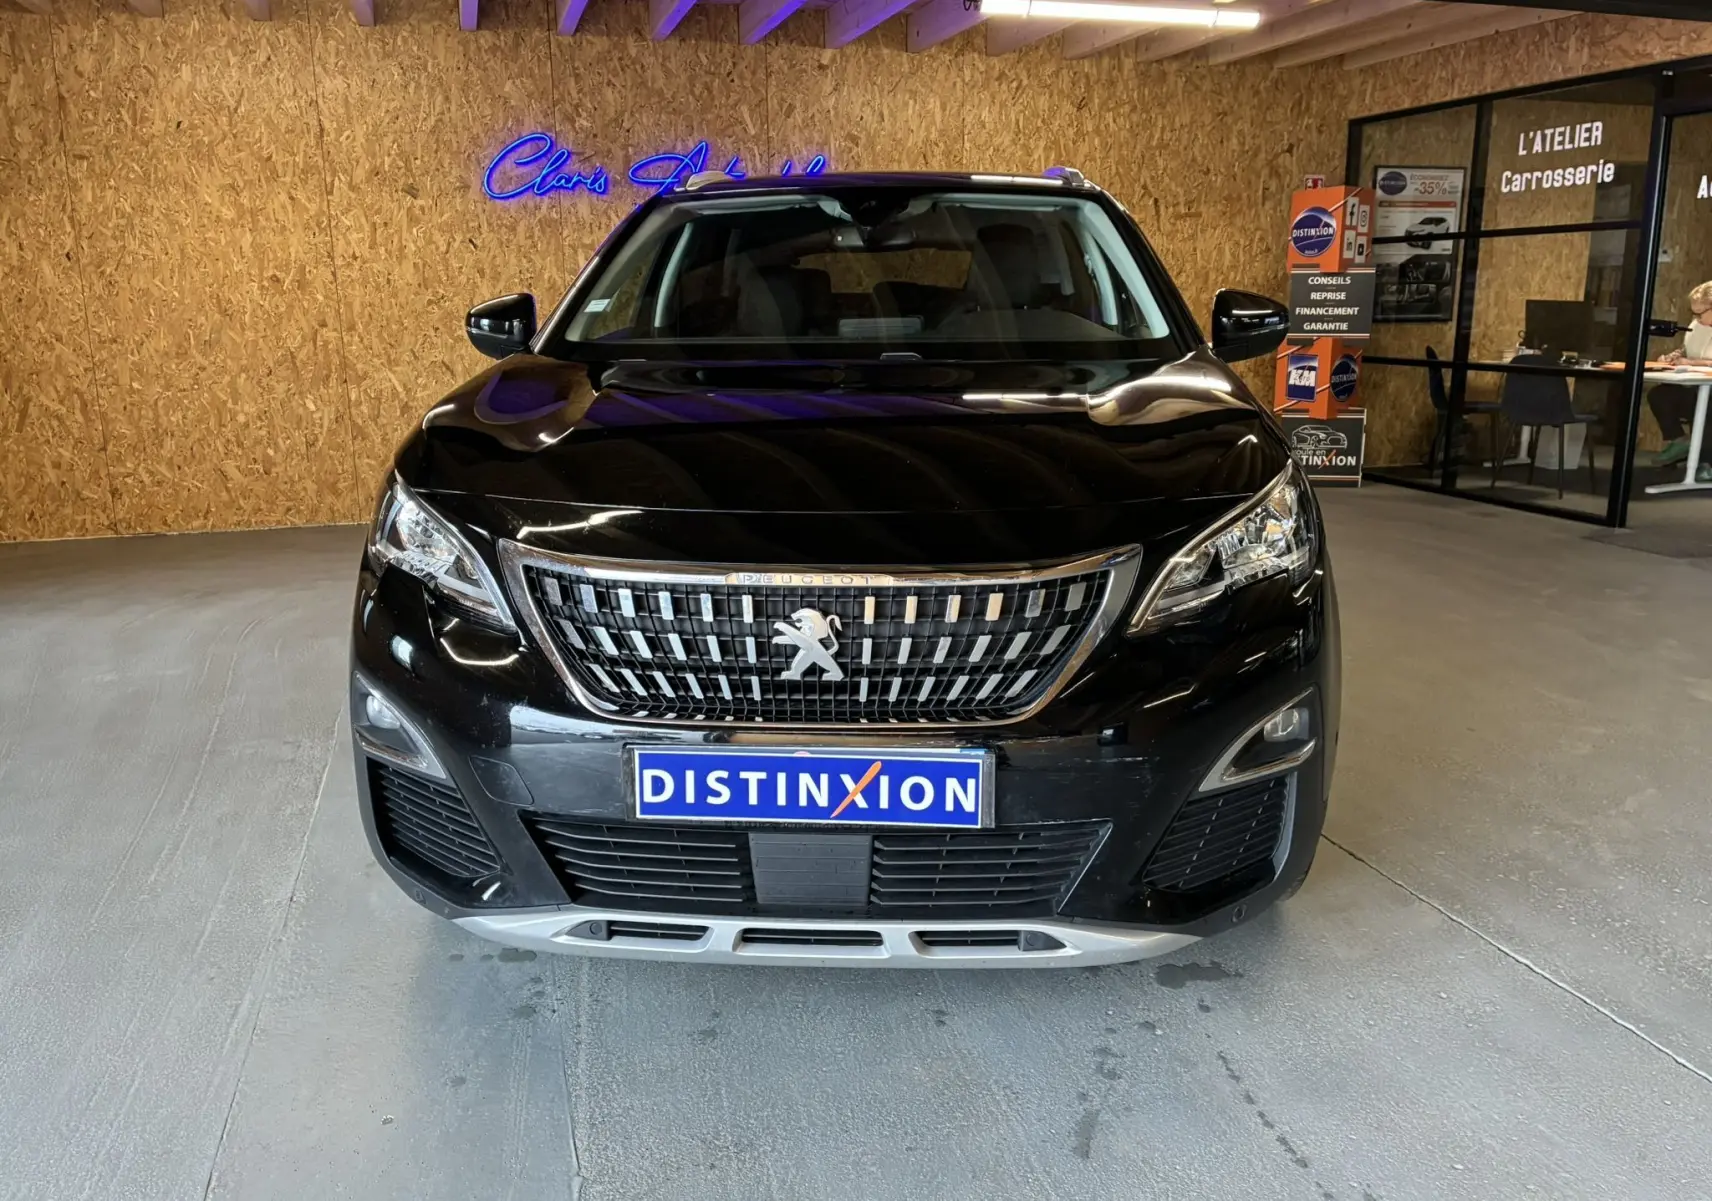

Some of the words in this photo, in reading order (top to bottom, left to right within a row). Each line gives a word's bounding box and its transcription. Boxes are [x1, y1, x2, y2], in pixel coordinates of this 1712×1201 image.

[1518, 121, 1603, 156] L'ATELIER
[483, 132, 607, 199] Claris
[1501, 159, 1615, 193] Carrosserie
[1697, 175, 1712, 198] A
[1292, 226, 1334, 238] DISTINXION
[1308, 276, 1351, 285] CONSEILS
[1310, 292, 1346, 300] REPRISE
[1295, 307, 1359, 315] FINANCEMENT
[1303, 322, 1348, 330] GARANTIE
[1295, 448, 1314, 456] oule
[1300, 454, 1356, 467] TINXION
[742, 573, 873, 585] PEUGEOT
[642, 761, 976, 818] DISTINXION
